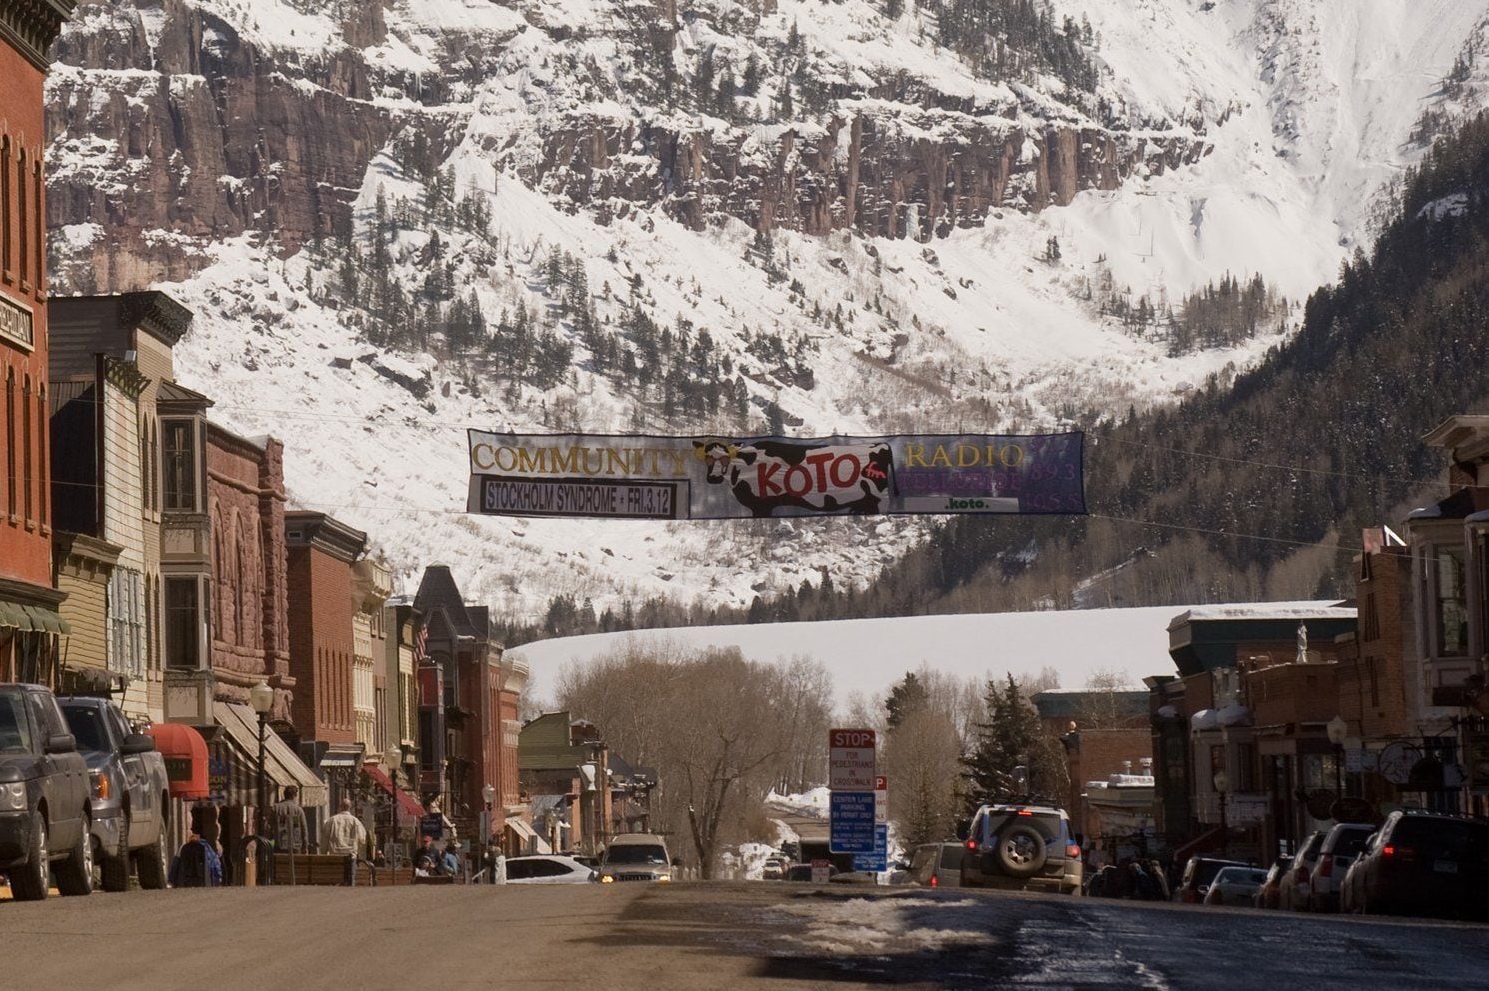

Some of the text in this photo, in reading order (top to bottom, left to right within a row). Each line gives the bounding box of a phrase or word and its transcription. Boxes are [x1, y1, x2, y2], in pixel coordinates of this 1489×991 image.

[472, 443, 689, 476] COMMUNITY
[905, 442, 1025, 469] RADIO
[757, 453, 861, 498] KOTO
[487, 481, 554, 510] STOCKHOLM
[557, 484, 617, 513] SYNDROME
[835, 732, 871, 747] STOP
[832, 760, 873, 769] PEDESTRIANS
[845, 751, 859, 760] FOR
[833, 777, 871, 786] CROSSWALK
